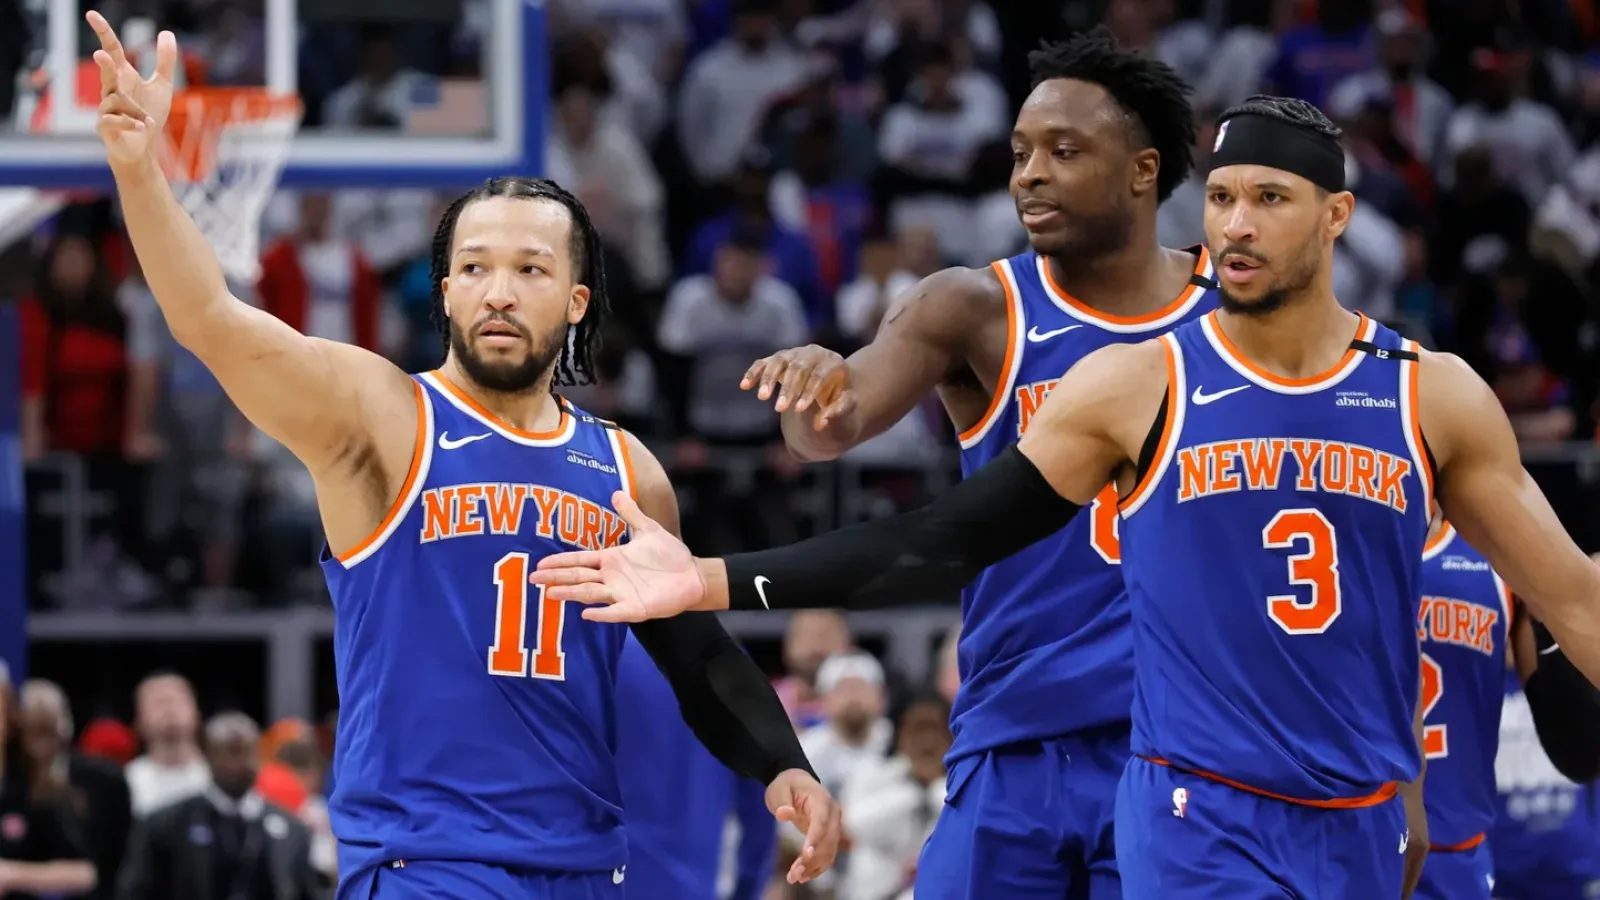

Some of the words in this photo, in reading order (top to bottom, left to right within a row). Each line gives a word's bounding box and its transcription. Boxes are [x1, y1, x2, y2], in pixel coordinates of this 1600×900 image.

[1376, 348, 1390, 359] 12
[1335, 397, 1360, 407] abu
[1361, 397, 1396, 408] dhabi
[1177, 437, 1286, 504] NEW
[1288, 438, 1412, 515] YORK
[420, 482, 526, 544] NEW
[531, 486, 628, 551] YORK
[1262, 508, 1342, 635] 3
[488, 552, 565, 681] 11
